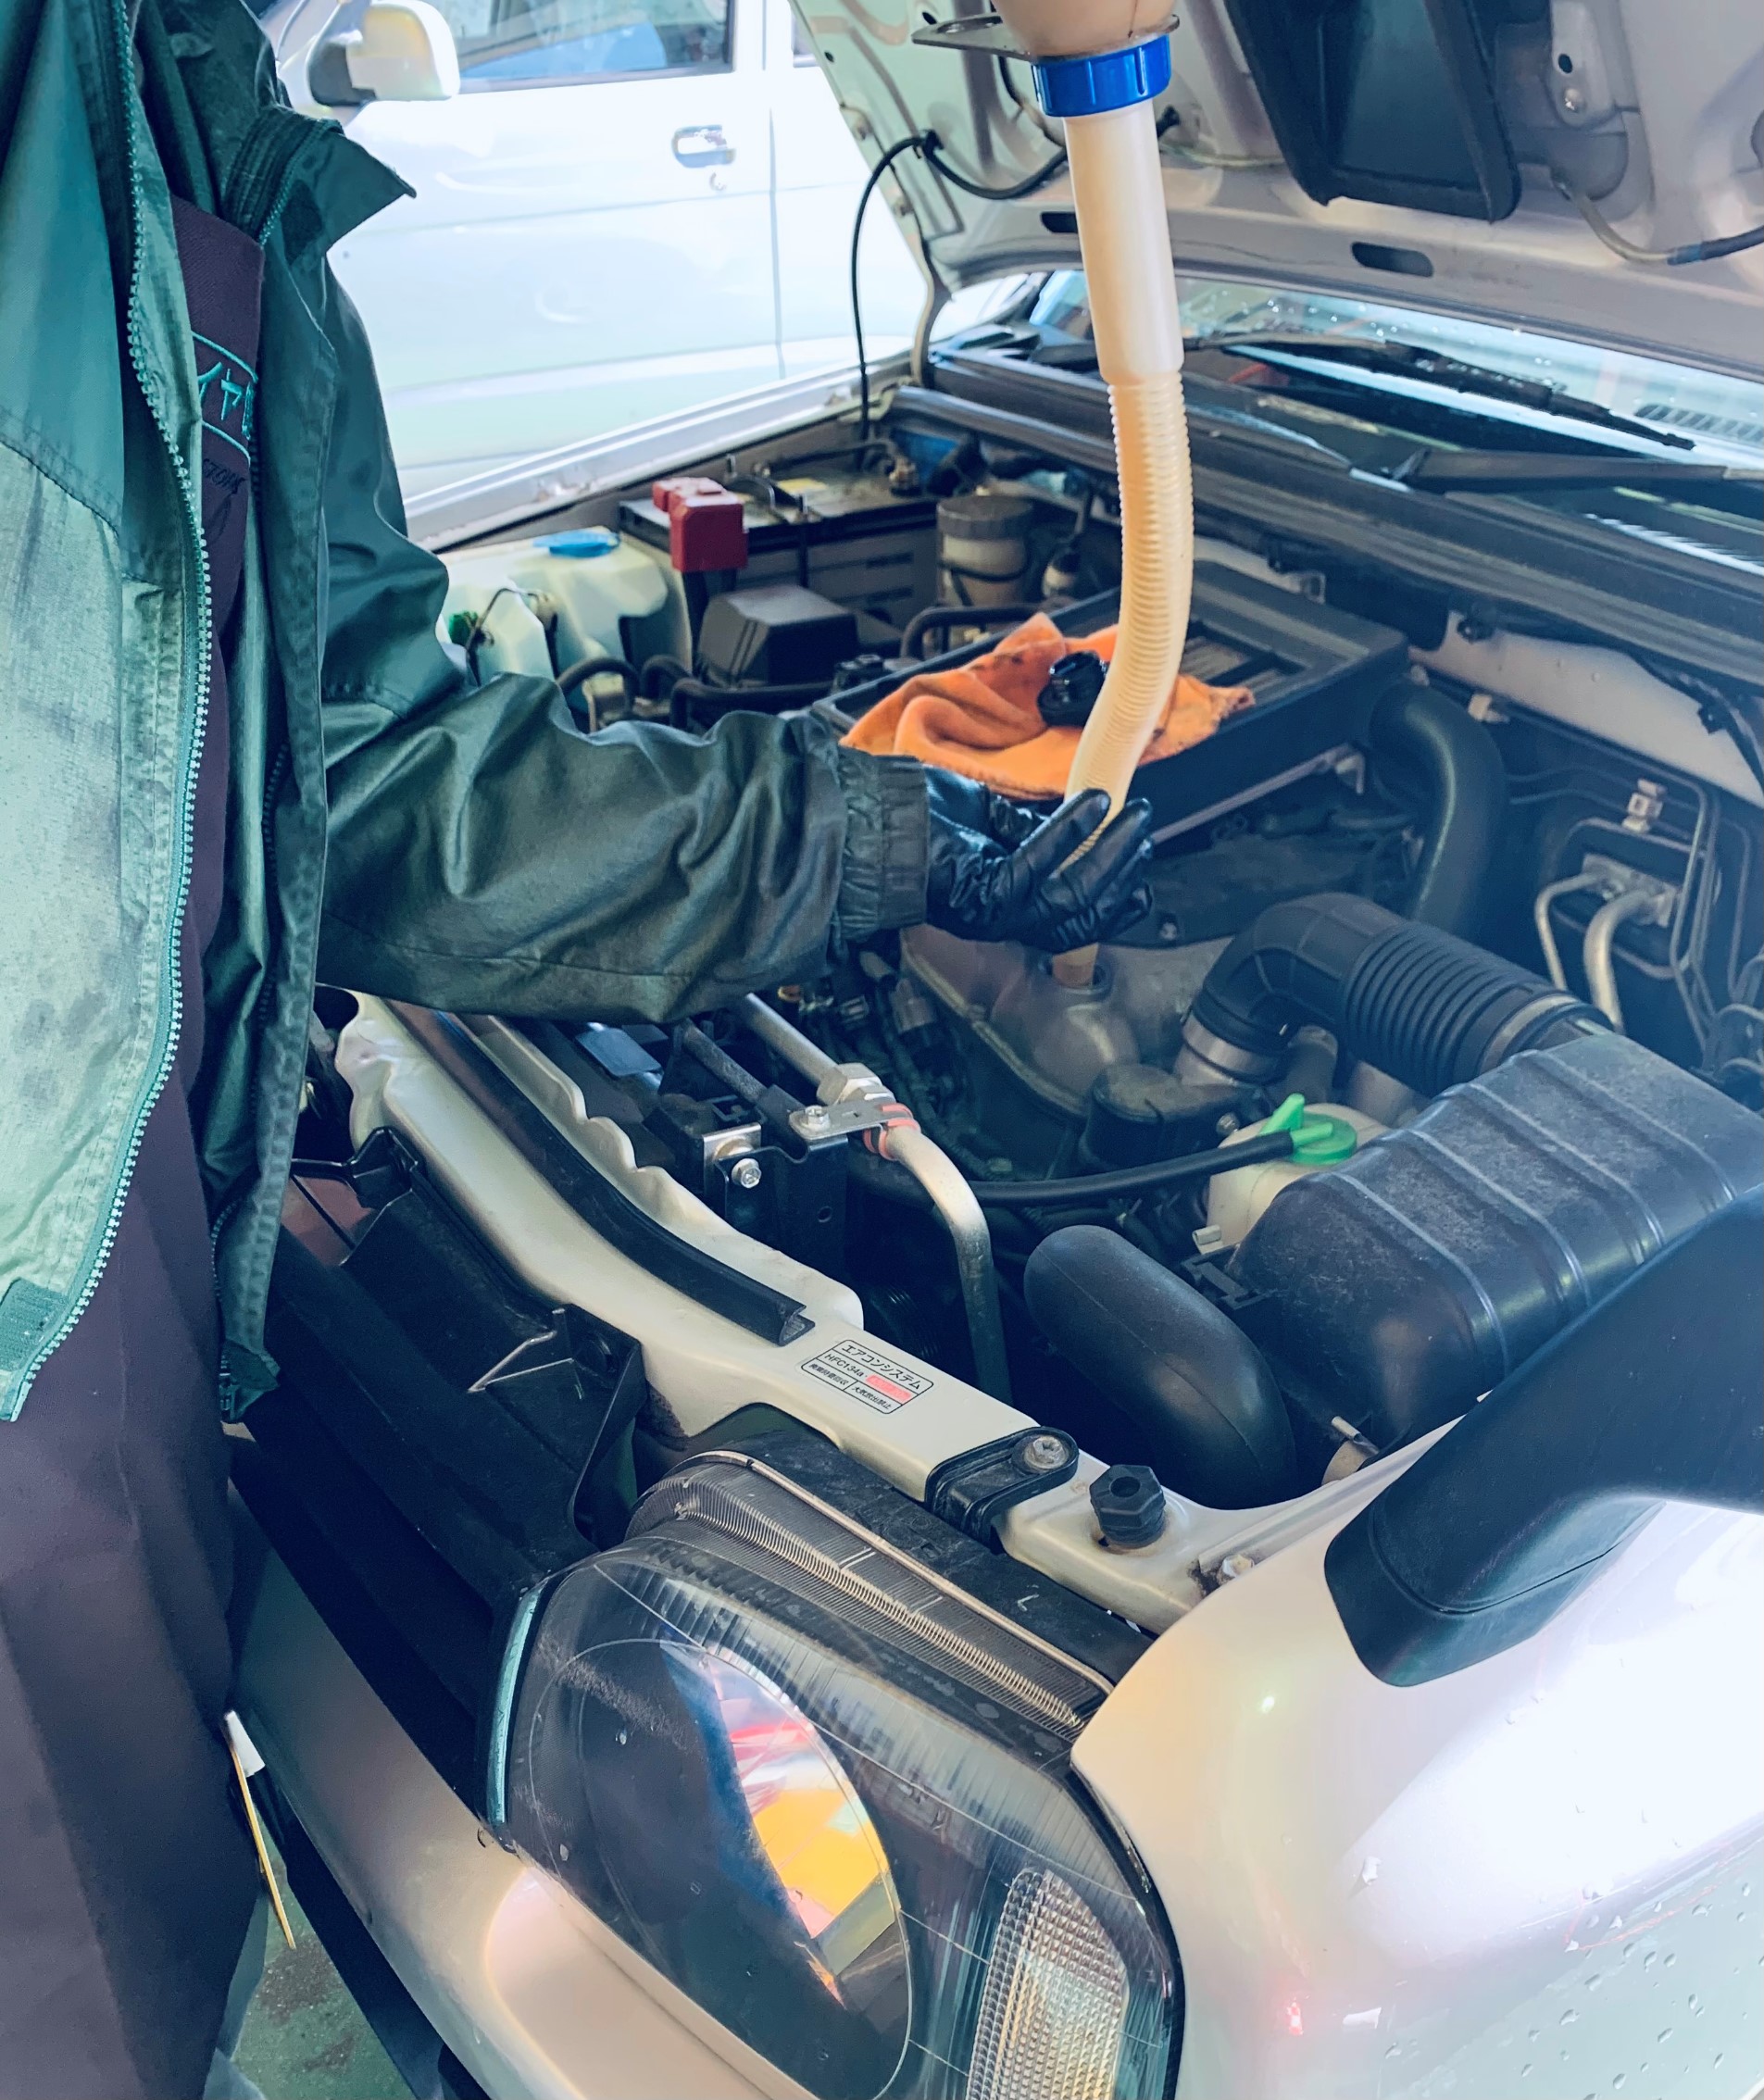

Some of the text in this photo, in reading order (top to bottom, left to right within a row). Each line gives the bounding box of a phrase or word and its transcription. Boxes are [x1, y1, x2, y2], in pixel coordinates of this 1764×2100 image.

[842, 1344, 921, 1390] エアコンシステム
